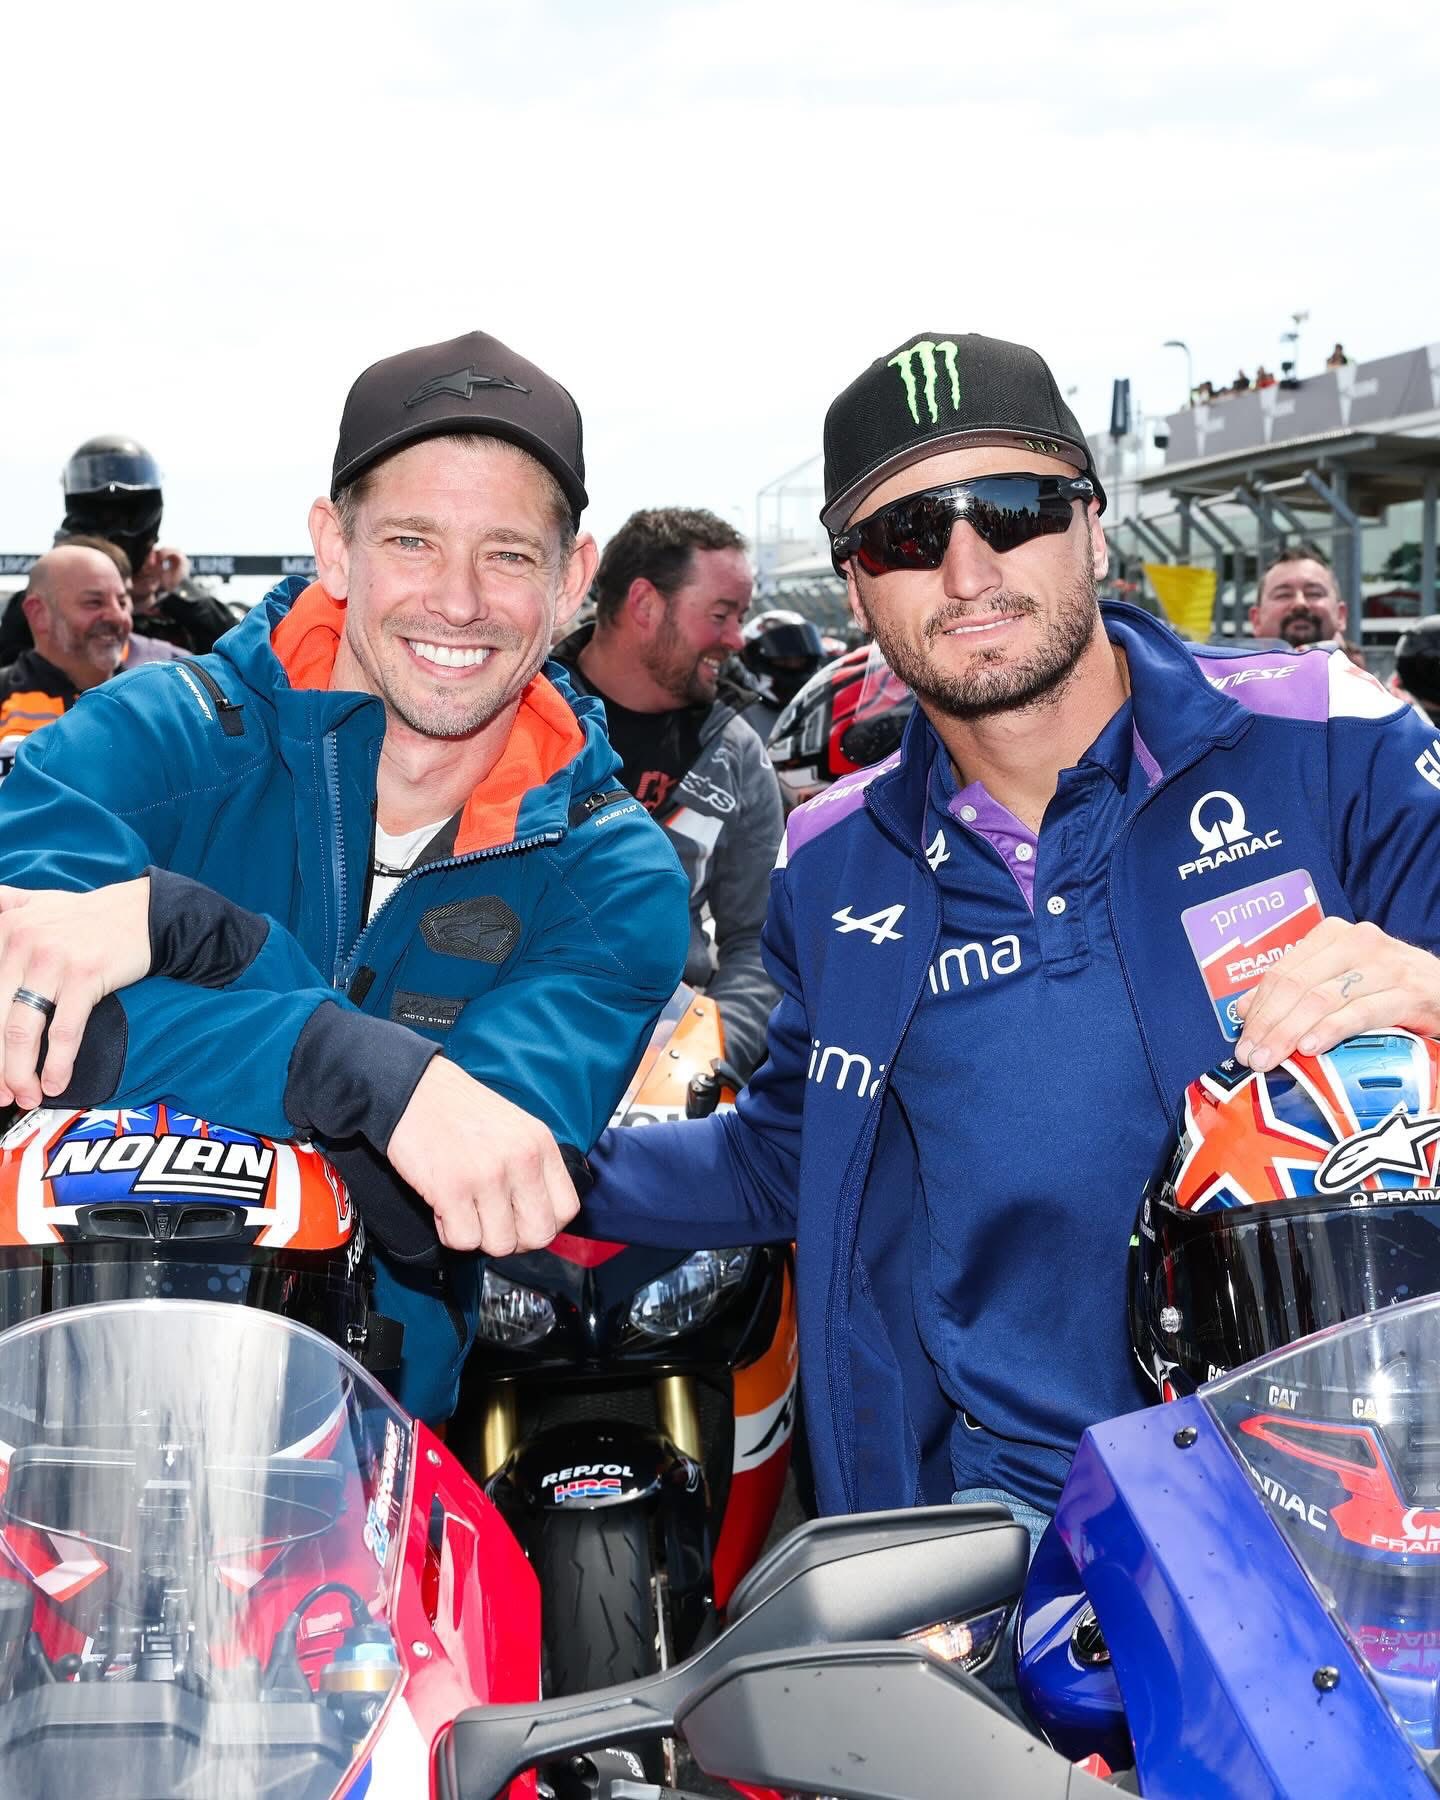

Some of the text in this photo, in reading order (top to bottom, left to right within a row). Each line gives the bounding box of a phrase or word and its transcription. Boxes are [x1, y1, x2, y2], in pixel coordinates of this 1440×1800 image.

[1178, 829, 1283, 881] PRAMAC
[1210, 890, 1285, 935] prima
[43, 1134, 275, 1200] NOLAN
[1268, 1385, 1300, 1411] CAT
[541, 1463, 635, 1489] REPSOL
[553, 1477, 623, 1505] HRC
